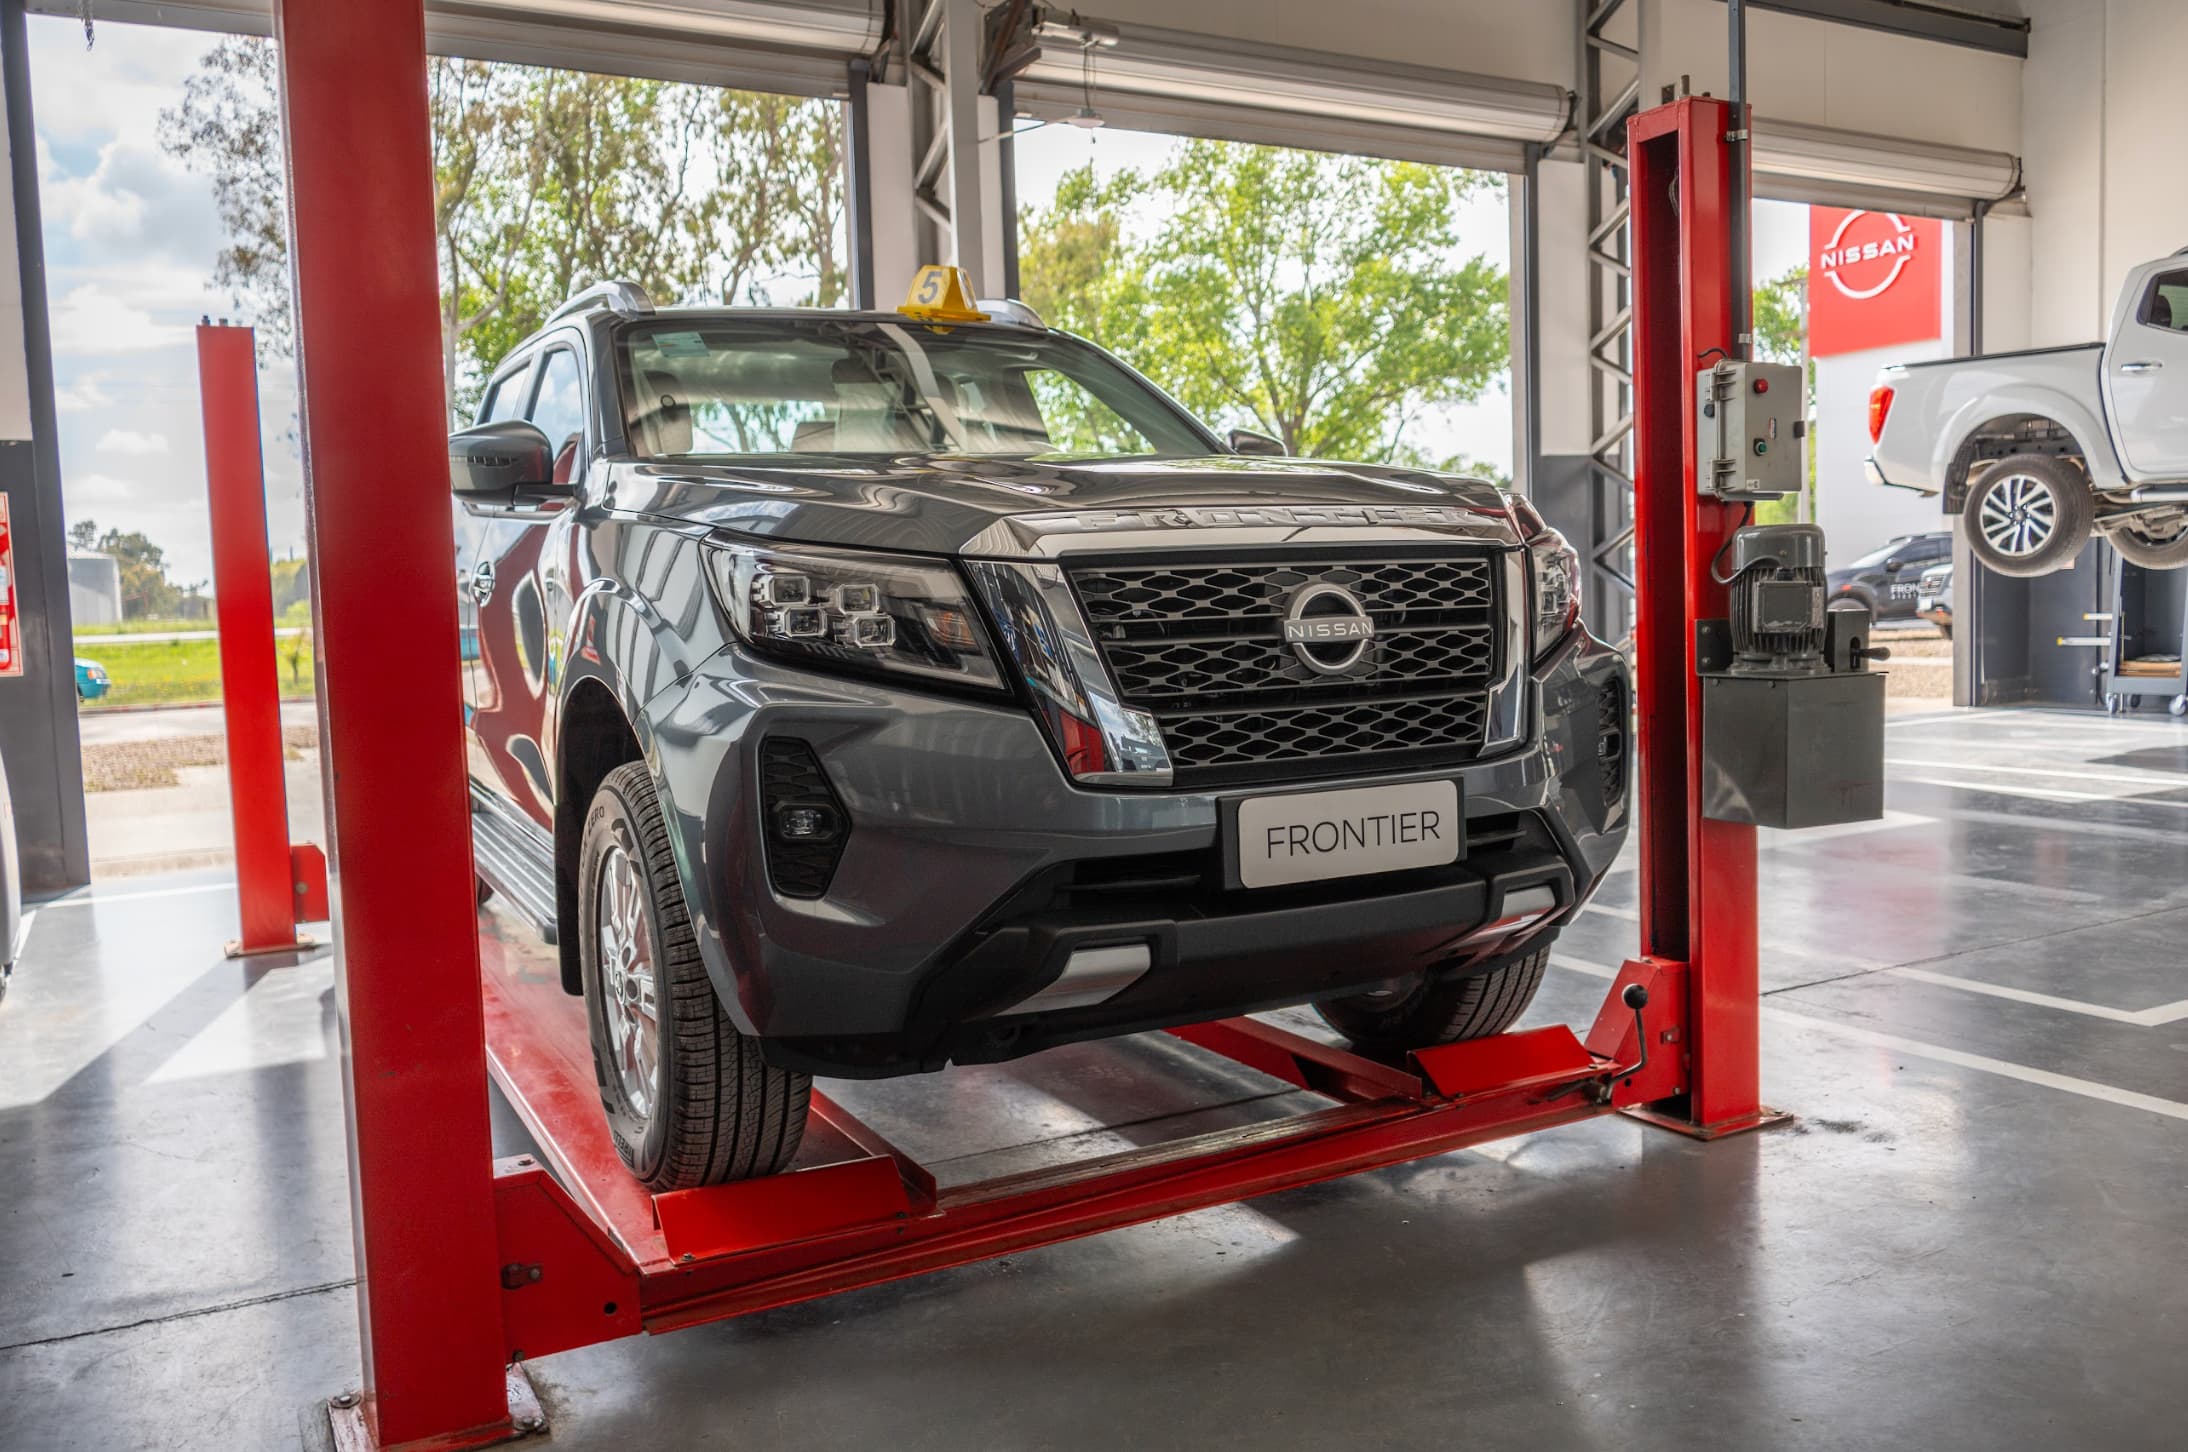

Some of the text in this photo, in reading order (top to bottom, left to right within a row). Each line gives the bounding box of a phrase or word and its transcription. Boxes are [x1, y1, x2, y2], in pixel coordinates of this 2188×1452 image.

[1821, 234, 1914, 270] NISSAN
[918, 270, 943, 304] 5
[1076, 506, 1474, 529] FRONTIER
[1890, 583, 1920, 594] FRON
[1287, 622, 1372, 638] NISSAN
[587, 806, 605, 837] ZERO
[1267, 810, 1440, 859] FRONTIER
